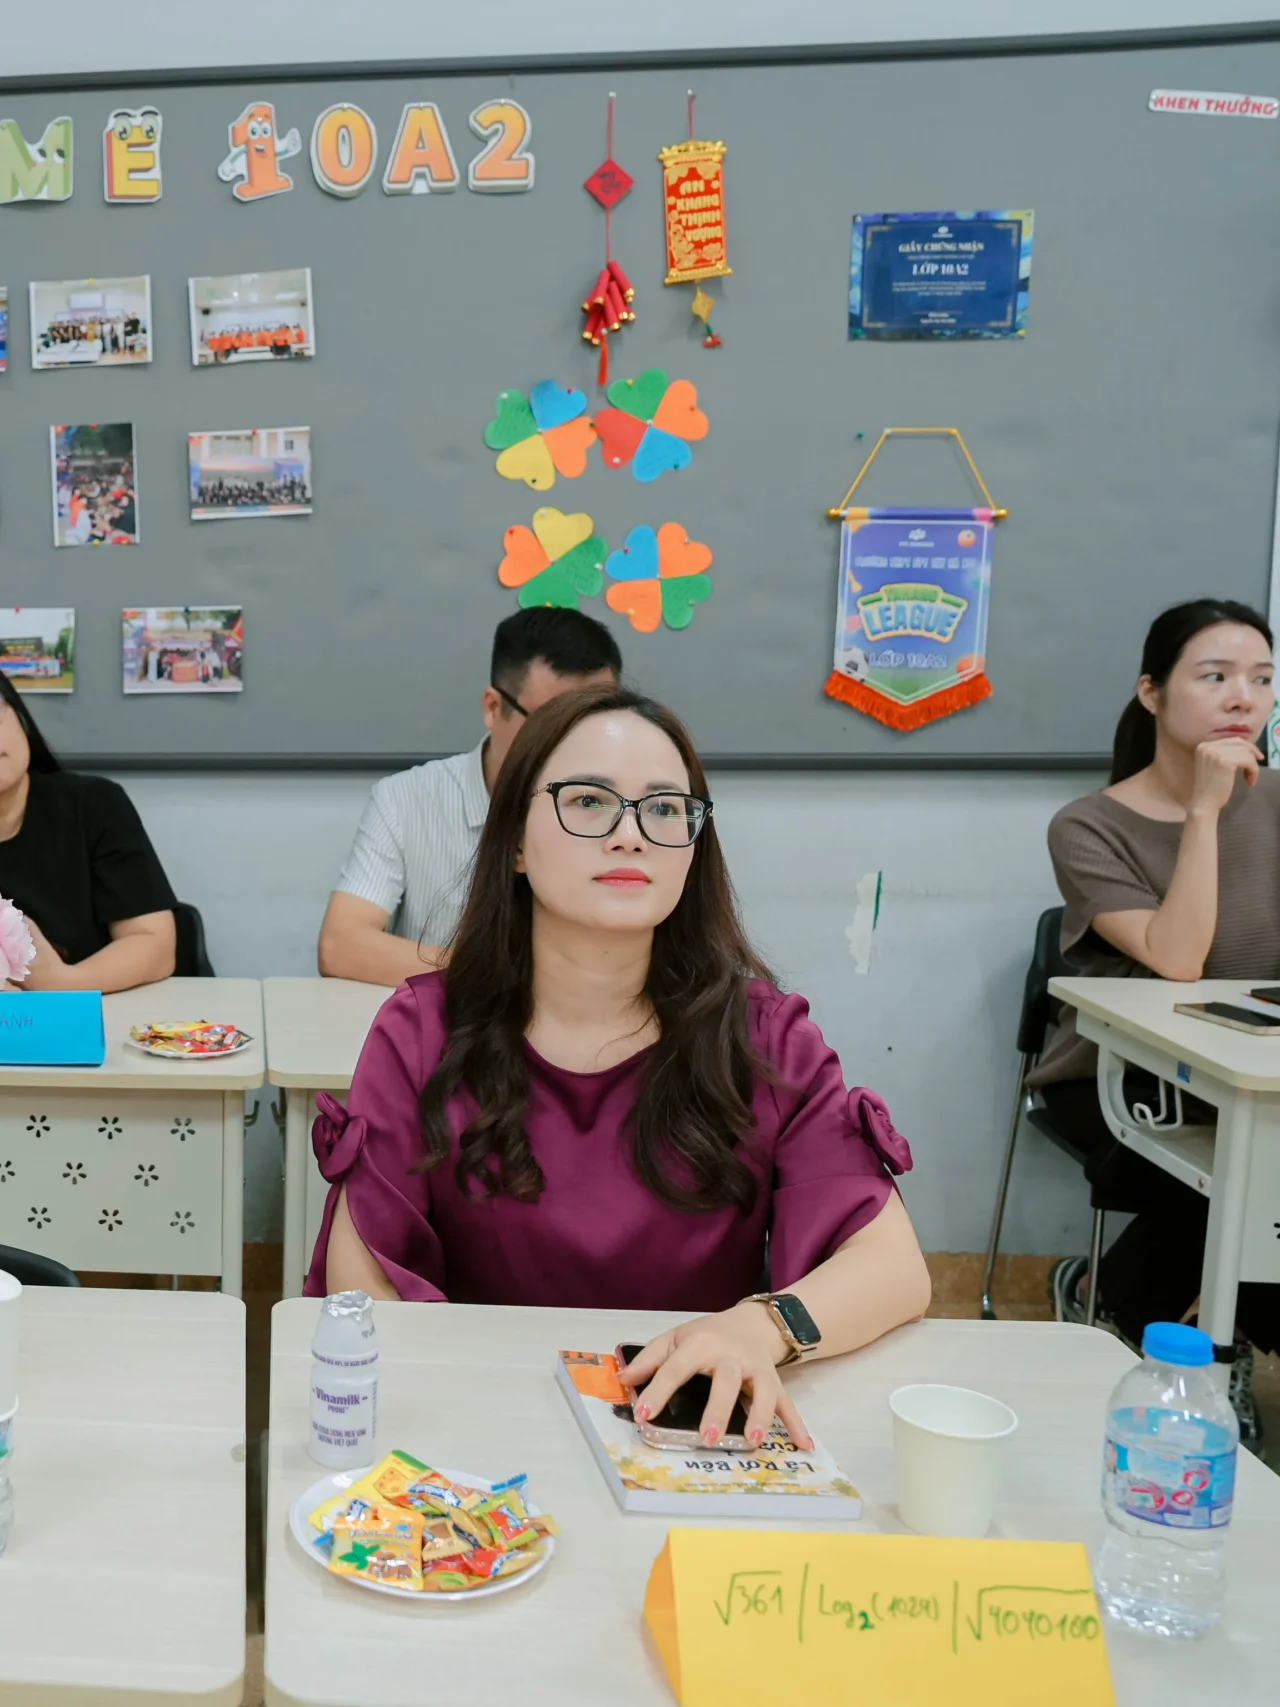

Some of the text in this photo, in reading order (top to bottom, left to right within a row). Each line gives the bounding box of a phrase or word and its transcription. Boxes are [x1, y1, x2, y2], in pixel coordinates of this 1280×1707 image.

[217, 98, 535, 201] 10A2
[862, 600, 959, 638] LEAGUE
[315, 1386, 360, 1405] Vinamilk
[684, 1460, 732, 1473] Bên
[784, 1460, 815, 1474] Lá
